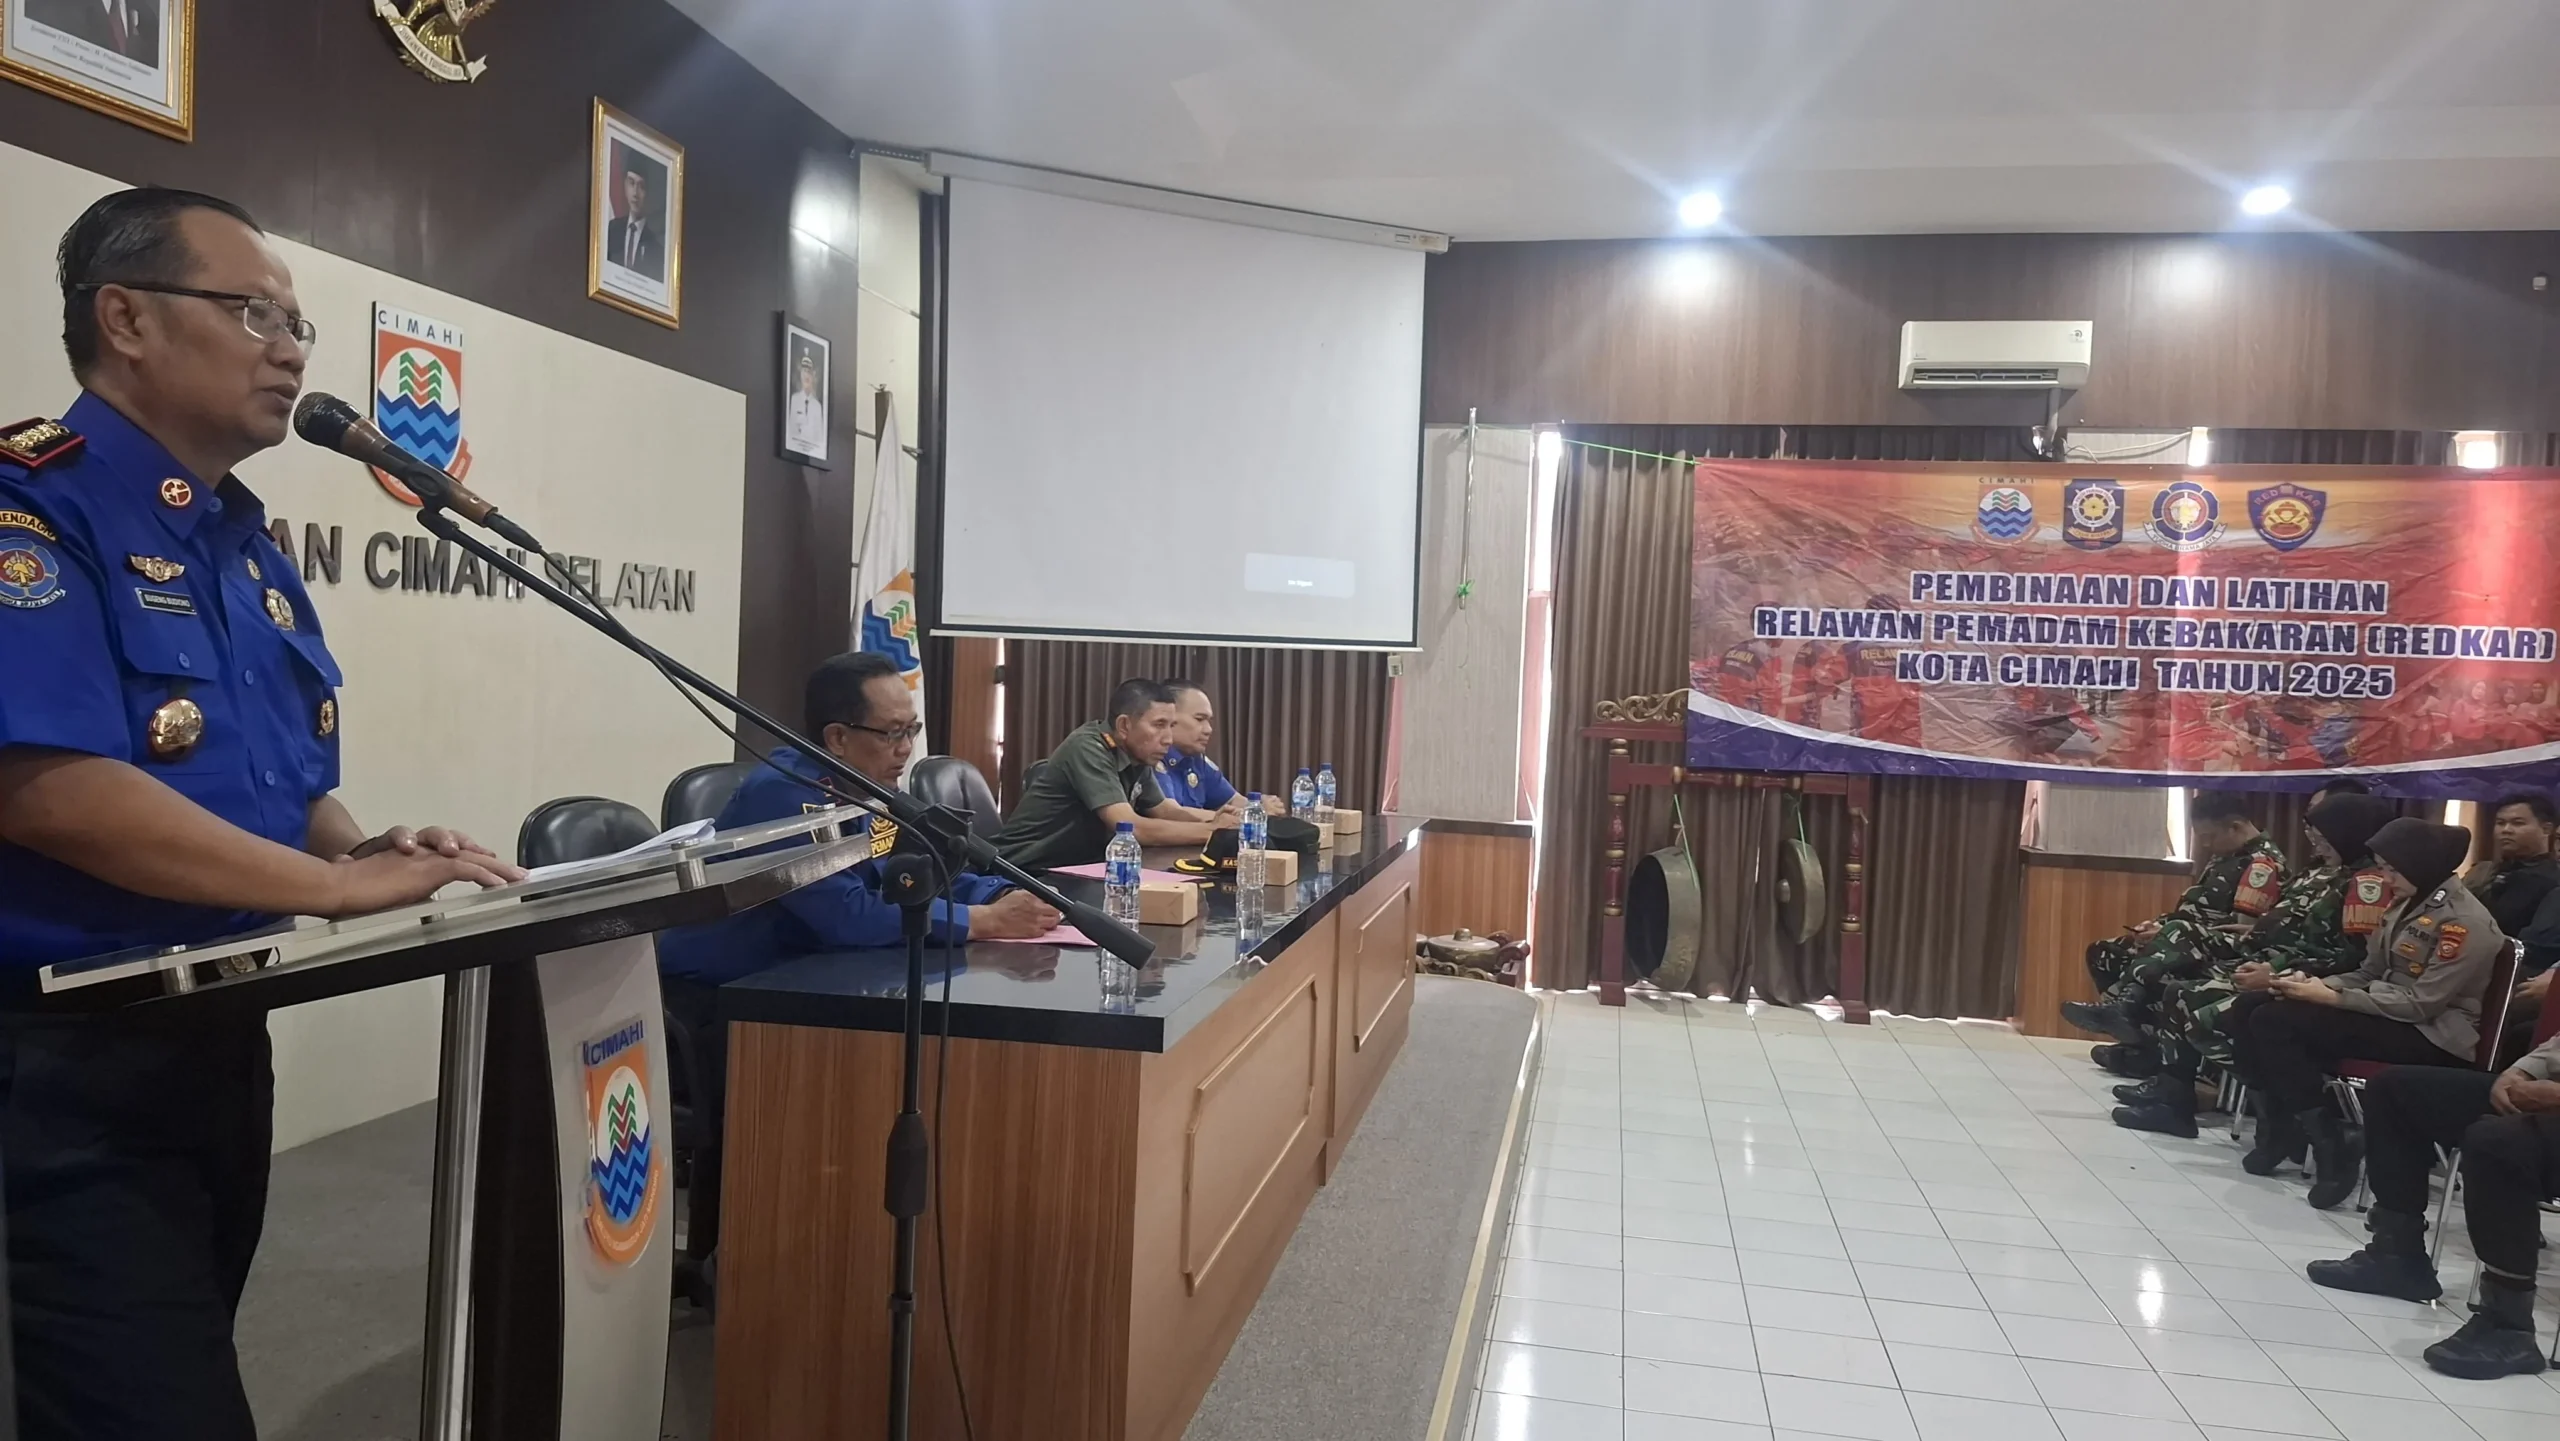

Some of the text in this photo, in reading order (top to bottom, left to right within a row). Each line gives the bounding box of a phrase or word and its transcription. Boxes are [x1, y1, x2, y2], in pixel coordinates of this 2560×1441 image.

[378, 310, 463, 347] CIMAHI
[1978, 476, 2035, 485] CIMAHI
[267, 518, 696, 613] AN CIMAHI SELATAN
[1911, 572, 2386, 613] PEMBINAAN DAN LATIHAN
[1755, 608, 2556, 661] RELAWAN PEMADAM KEBAKARAN (REDKAR)
[1897, 650, 2395, 699] KOTA CIMAHI TAHUN 2025
[1223, 859, 1238, 868] KAS
[590, 1020, 644, 1065] CIMAHI
